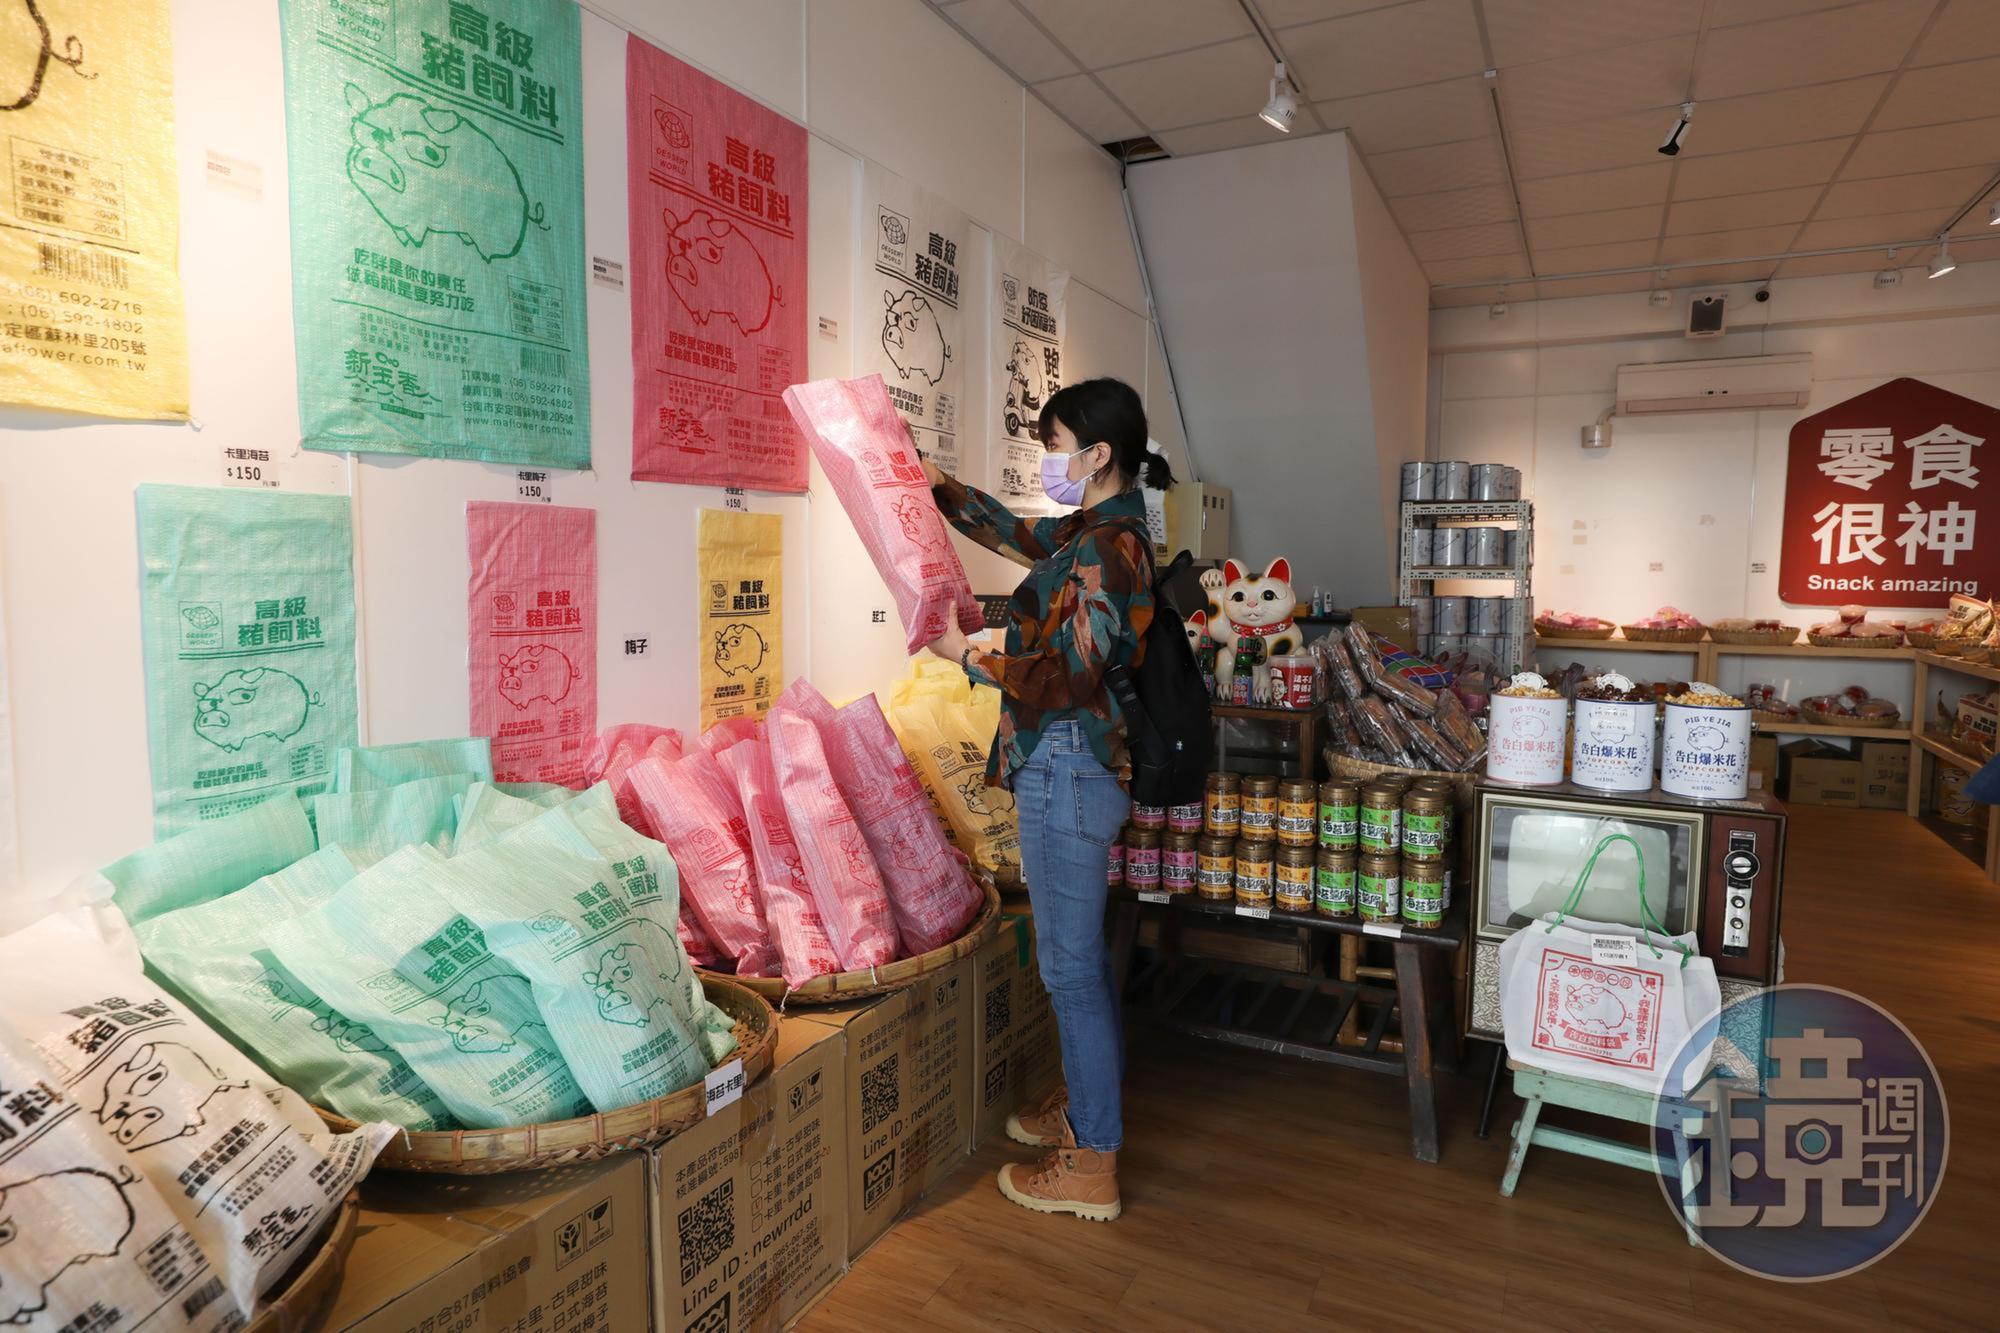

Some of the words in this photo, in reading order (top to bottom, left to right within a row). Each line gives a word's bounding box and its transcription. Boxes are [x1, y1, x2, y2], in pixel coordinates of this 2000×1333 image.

[449, 2, 535, 72] 高級
[421, 31, 558, 128] 豬飼料
[725, 136, 776, 185] 高級
[707, 161, 792, 227] 豬飼料
[929, 232, 957, 268] 高級
[354, 248, 467, 294] 吃胖是你的責任
[915, 253, 959, 300] 豬飼料
[60, 291, 143, 316] 592-2716
[1027, 286, 1048, 313] 防疫
[63, 311, 144, 335] 592-4802
[0, 322, 148, 356] 定區蘇林里205號
[886, 385, 923, 406] 胖是你的責任
[224, 447, 270, 462] 卡里海苔
[1816, 423, 1987, 492] 零食
[1811, 500, 1977, 566] 很神
[537, 591, 571, 607] 高級
[740, 580, 764, 594] 高級
[1807, 574, 1875, 592] Snack
[1881, 576, 1979, 597] amazing
[255, 596, 307, 620] 高級
[733, 594, 770, 611] 豬飼料
[526, 607, 582, 628] 豬飼料
[237, 616, 323, 647] 豬飼料
[624, 639, 648, 655] 梅子
[1684, 716, 1700, 725] PIG
[1717, 718, 1732, 728] JIA
[1502, 737, 1556, 753] 告白爆米花
[1581, 742, 1638, 759] 告白爆米花
[1675, 749, 1737, 767] 告白爆米花
[573, 881, 612, 910] 高級
[580, 896, 632, 931] 豬飼料
[421, 918, 476, 959] 高級
[706, 1073, 746, 1103] 海苔卡里
[864, 1134, 888, 1160] Line
[683, 1278, 718, 1317] Line
[752, 1193, 813, 1259] newrrdd
